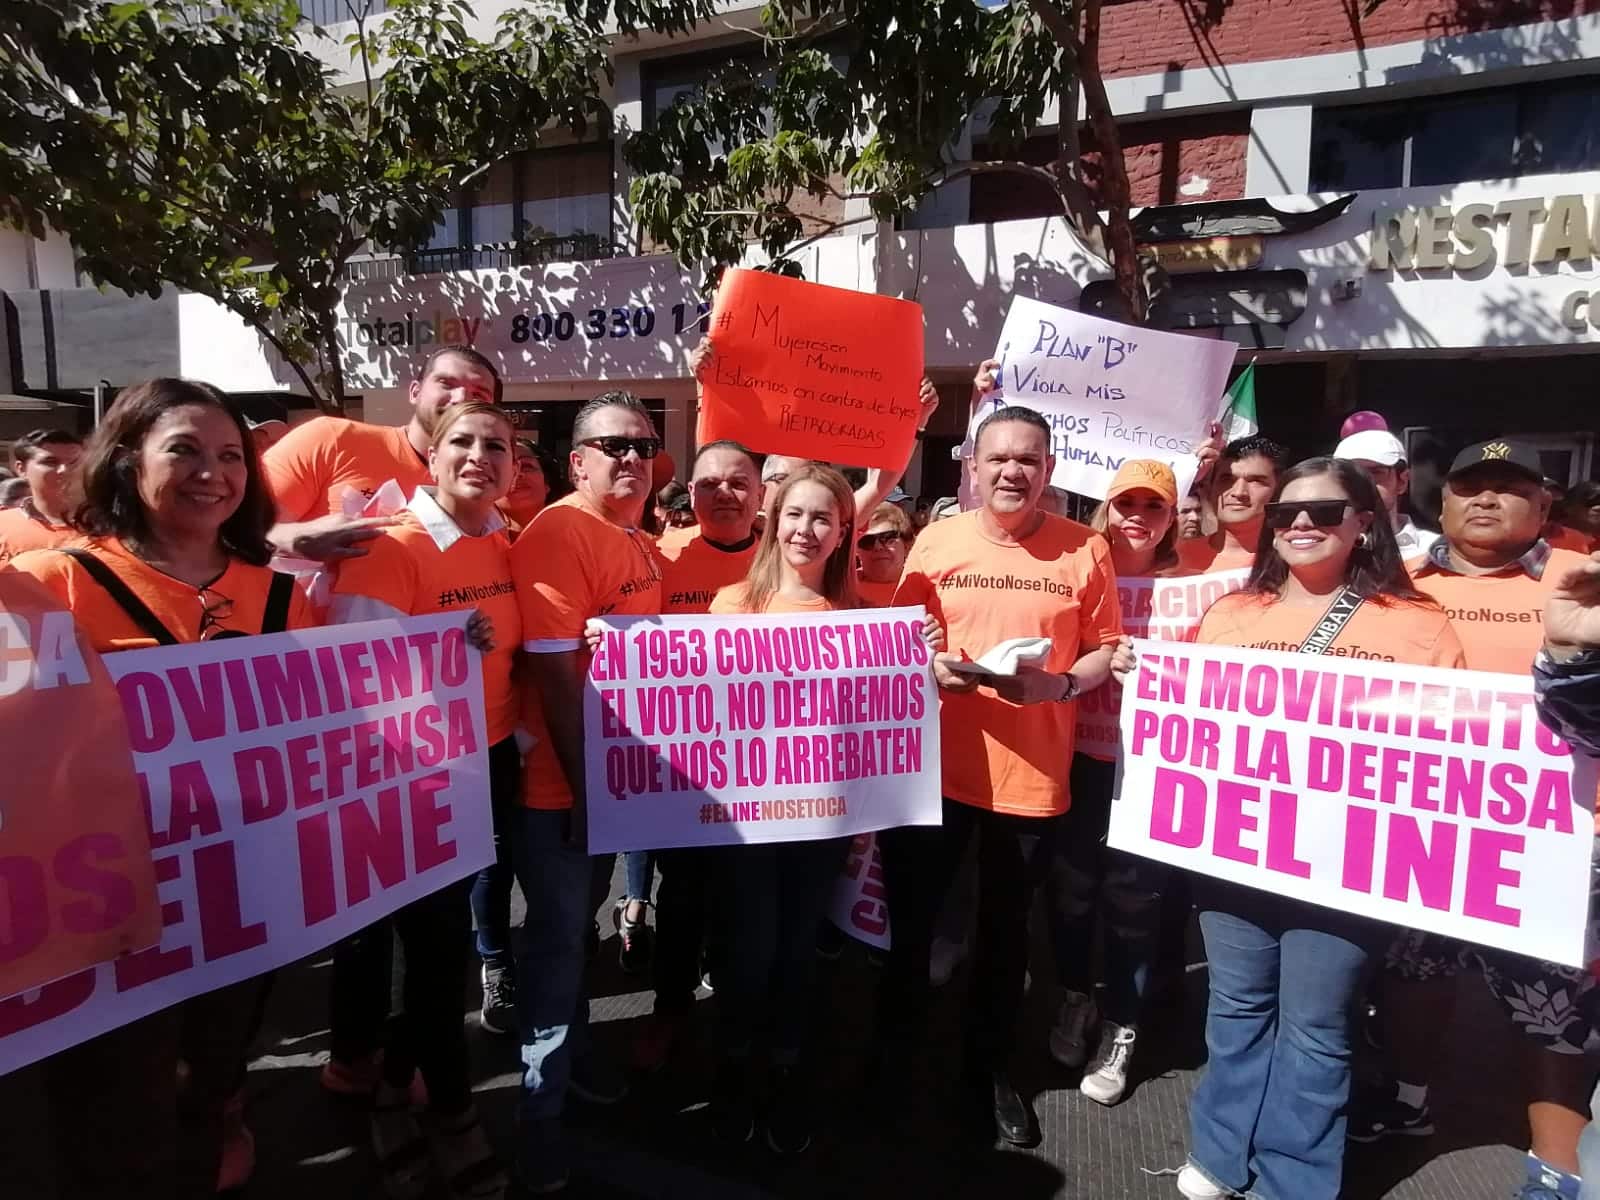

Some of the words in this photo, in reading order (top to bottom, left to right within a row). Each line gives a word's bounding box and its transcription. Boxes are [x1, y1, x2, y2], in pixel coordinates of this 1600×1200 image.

[1368, 194, 1600, 271] RESTA
[340, 309, 481, 353] Totalplay
[510, 311, 576, 343] 800
[586, 306, 656, 340] 330
[714, 355, 788, 395] Estamos
[1053, 434, 1126, 471] HUMAN
[939, 573, 1073, 598] #MiVotoNoseToca
[593, 631, 626, 681] EN
[634, 628, 707, 679] 1953
[715, 620, 928, 677] CONQUISTAMOS
[1136, 654, 1189, 705] EN
[115, 627, 471, 754] OVIMIENTO
[601, 688, 632, 738] EL
[637, 684, 721, 737] VOTO,
[728, 682, 765, 730] NO
[773, 673, 925, 729] DEJAREMOS
[233, 697, 478, 825] DEFENSA
[606, 744, 663, 800] QUE
[670, 739, 727, 792] NOS
[735, 737, 766, 787] LO
[774, 727, 922, 785] ARREBATEN
[1131, 709, 1220, 771] POR
[1233, 724, 1293, 785] LA
[1307, 735, 1575, 835] DEFENSA
[296, 770, 457, 928] INE
[1149, 766, 1312, 880] DEL
[1341, 804, 1526, 928] INE
